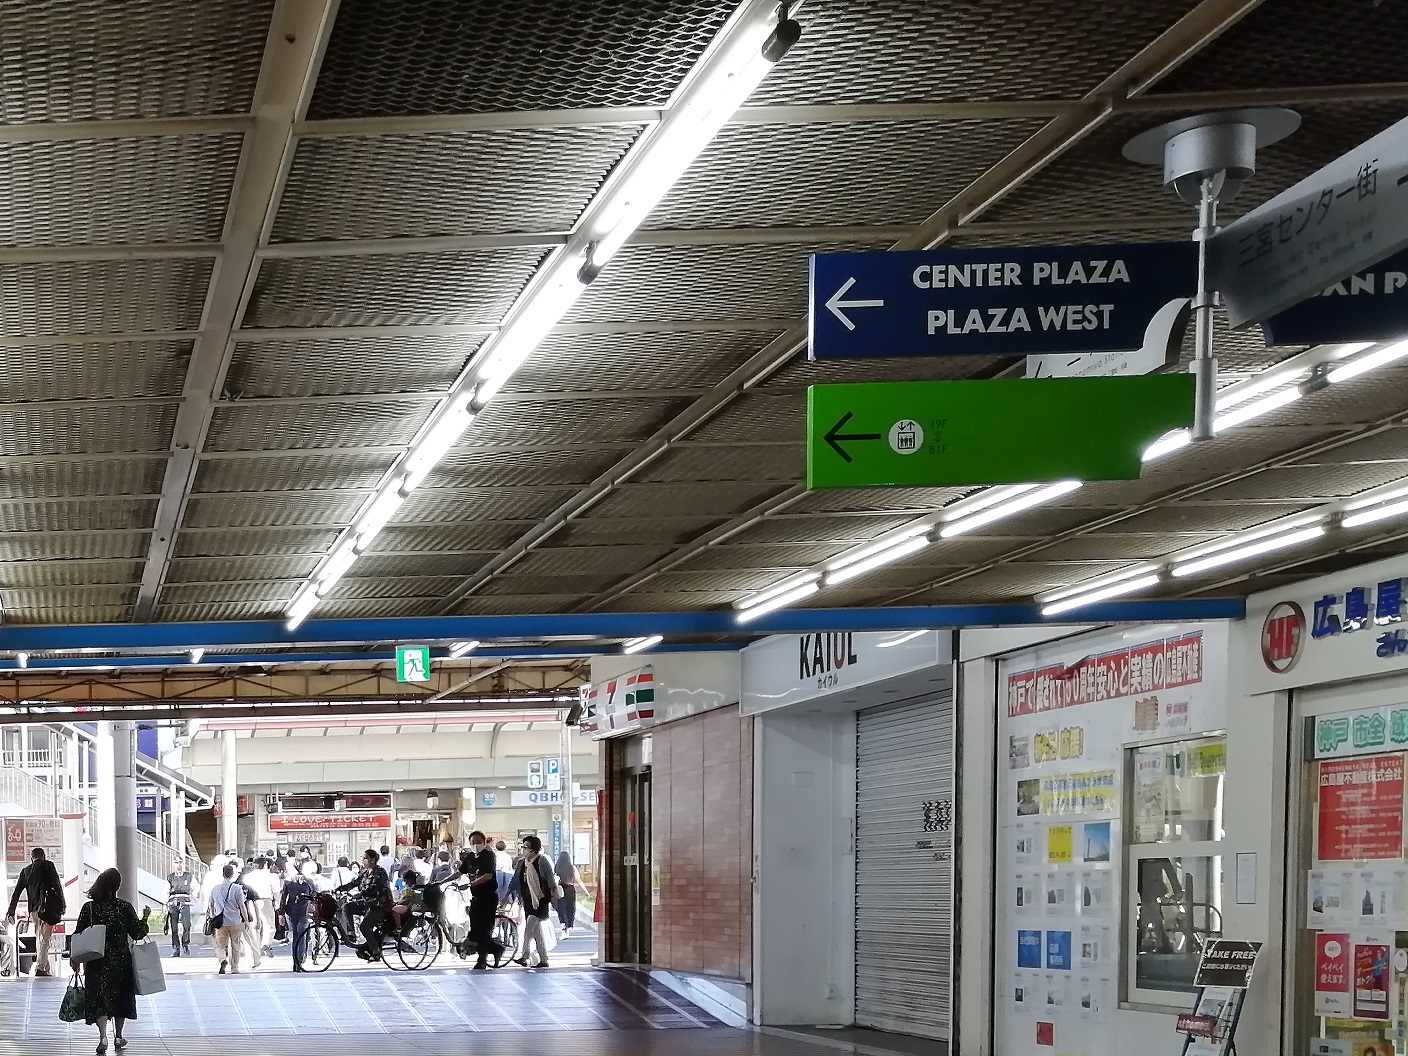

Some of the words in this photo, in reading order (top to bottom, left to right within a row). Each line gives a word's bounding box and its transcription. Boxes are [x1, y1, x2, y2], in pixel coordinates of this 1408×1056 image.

[1238, 158, 1379, 269] 三宮センター街
[912, 262, 1022, 289] CENTER
[1033, 259, 1131, 286] PLAZA
[1314, 273, 1375, 298] AN
[927, 307, 1031, 335] PLAZA
[1038, 304, 1115, 331] WEST
[549, 760, 558, 774] P
[281, 816, 289, 824] I
[292, 815, 323, 824] LOVE
[327, 814, 376, 823] TICKET
